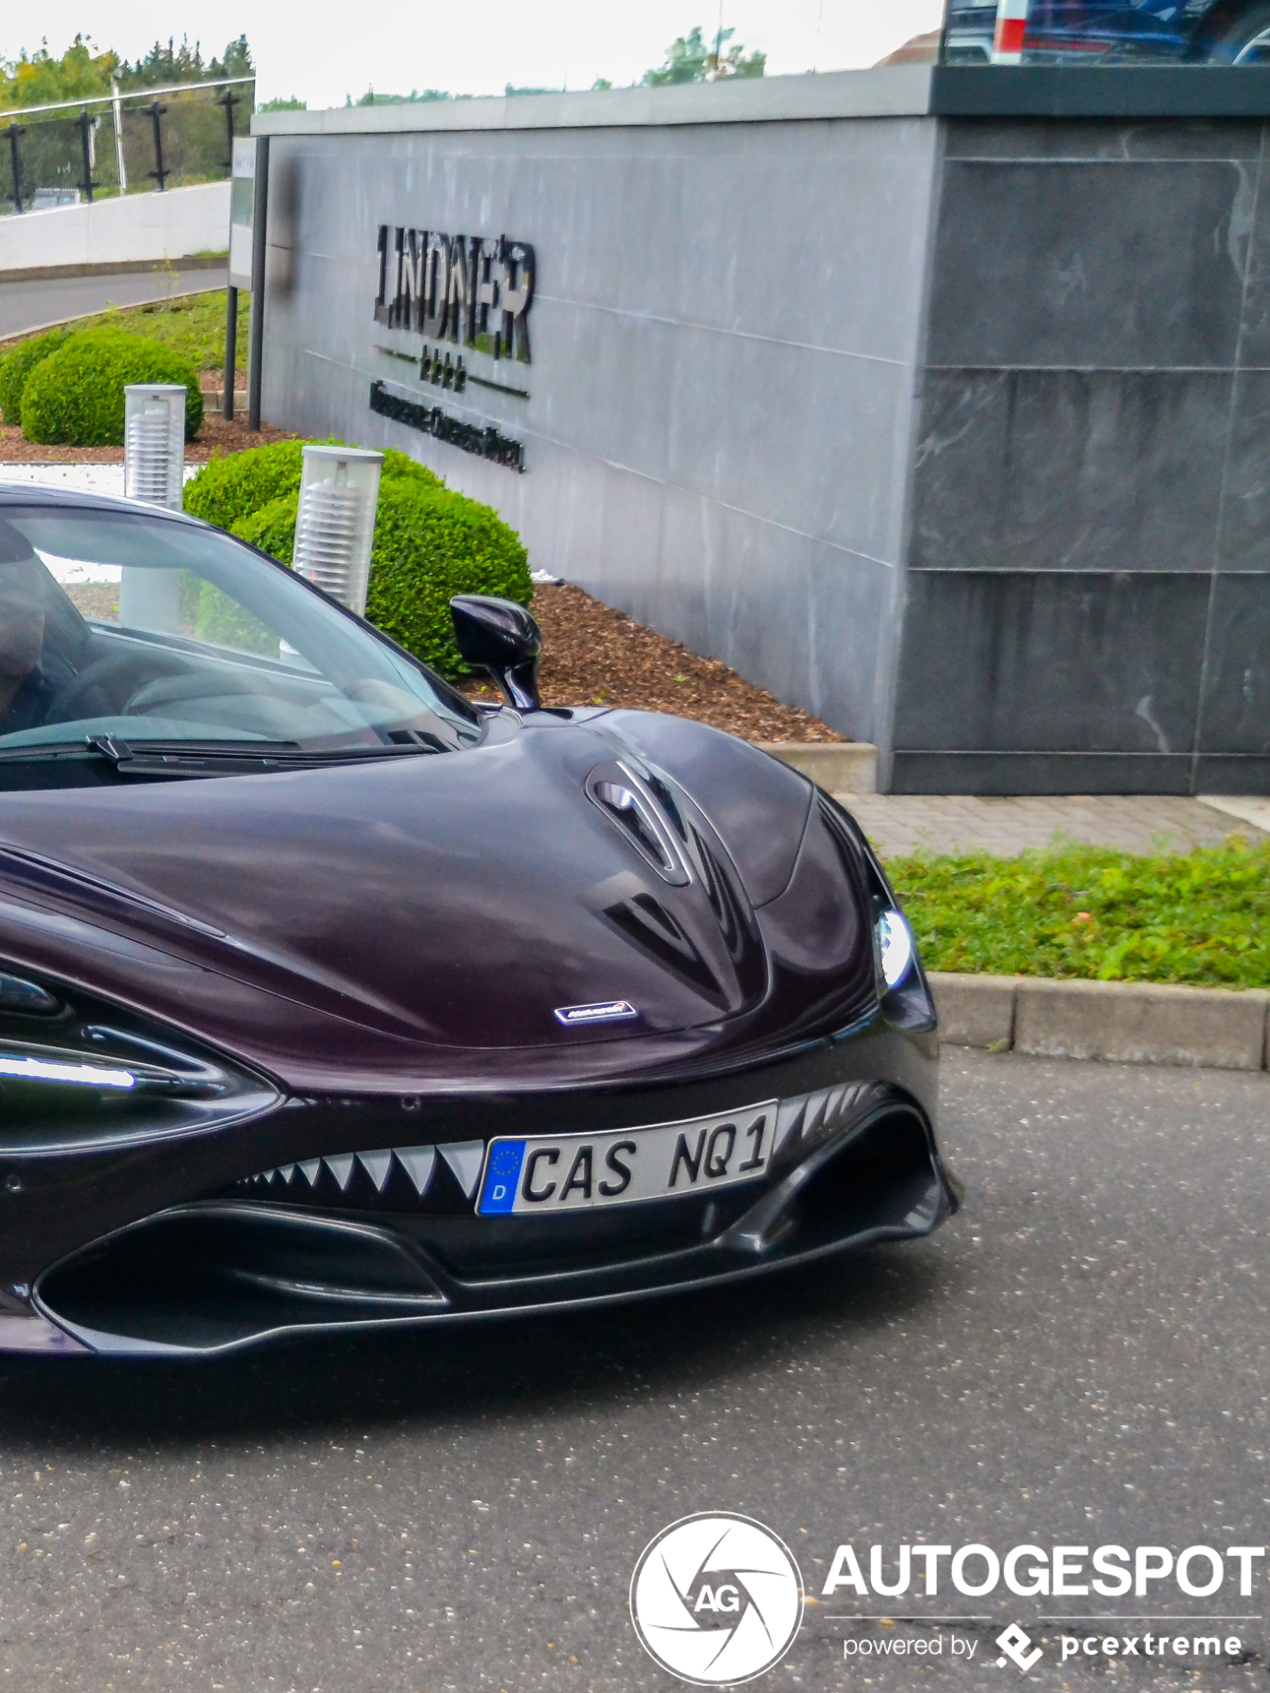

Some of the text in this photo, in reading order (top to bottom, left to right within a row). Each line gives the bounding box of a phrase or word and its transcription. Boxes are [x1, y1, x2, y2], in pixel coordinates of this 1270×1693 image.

[374, 225, 536, 364] LINDNER
[492, 1185, 506, 1200] D
[521, 1140, 637, 1202] CAS
